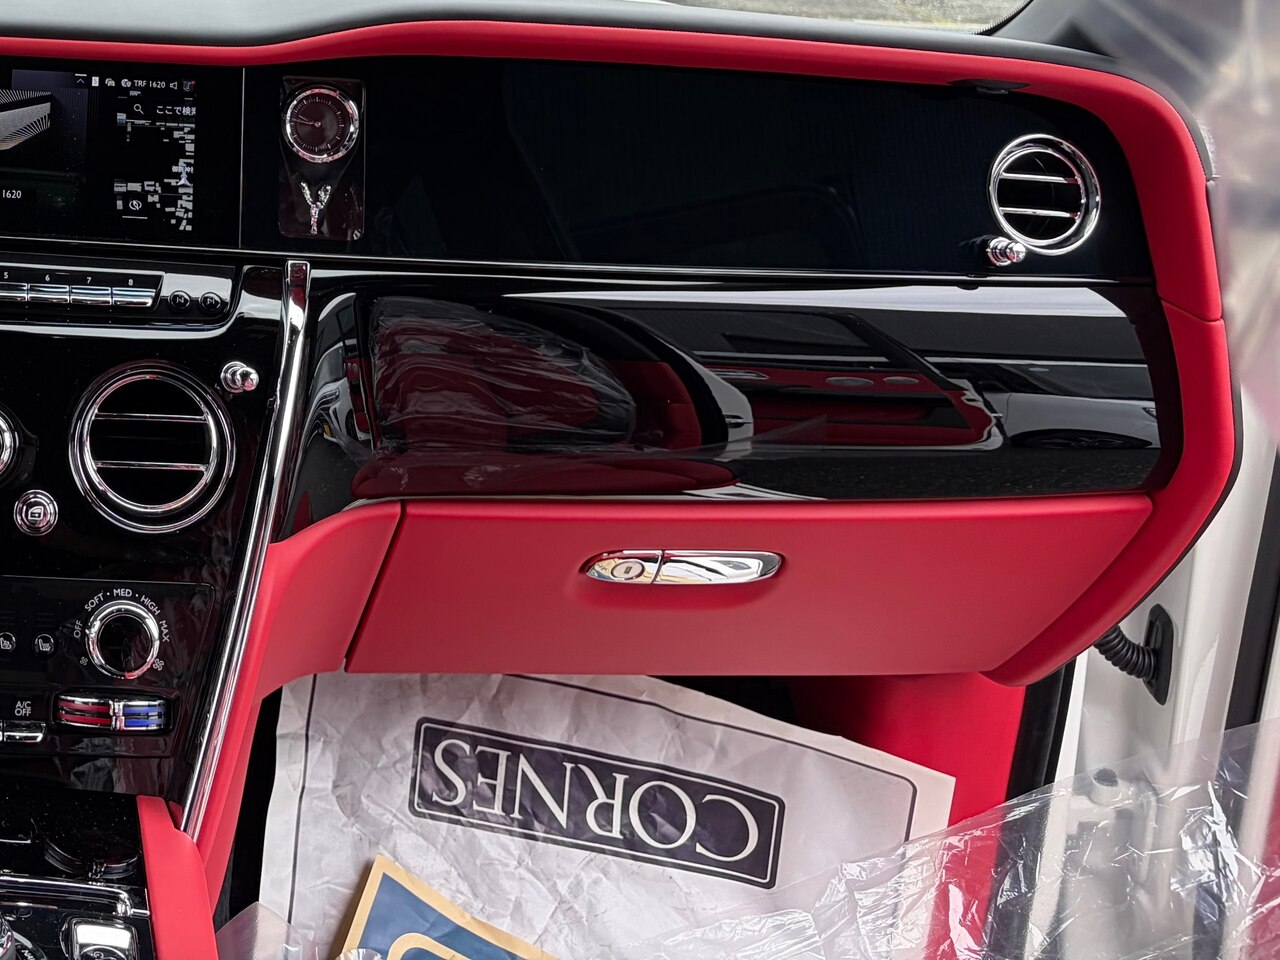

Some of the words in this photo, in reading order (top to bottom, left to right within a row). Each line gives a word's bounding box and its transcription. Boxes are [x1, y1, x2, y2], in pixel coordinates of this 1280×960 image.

[133, 79, 147, 87] TRF
[149, 80, 166, 89] 1620
[2, 189, 22, 199] 1620
[3, 271, 9, 279] 5
[45, 274, 50, 282] 6
[86, 276, 92, 284] 7
[128, 278, 133, 286] 8
[113, 588, 132, 597] MED
[84, 592, 104, 612] SOFT
[140, 595, 161, 615] HIGH
[73, 620, 83, 638] OFF
[159, 620, 170, 642] MAX
[15, 700, 31, 709] A/C
[14, 708, 31, 717] OFF
[432, 739, 757, 863] CORNES
